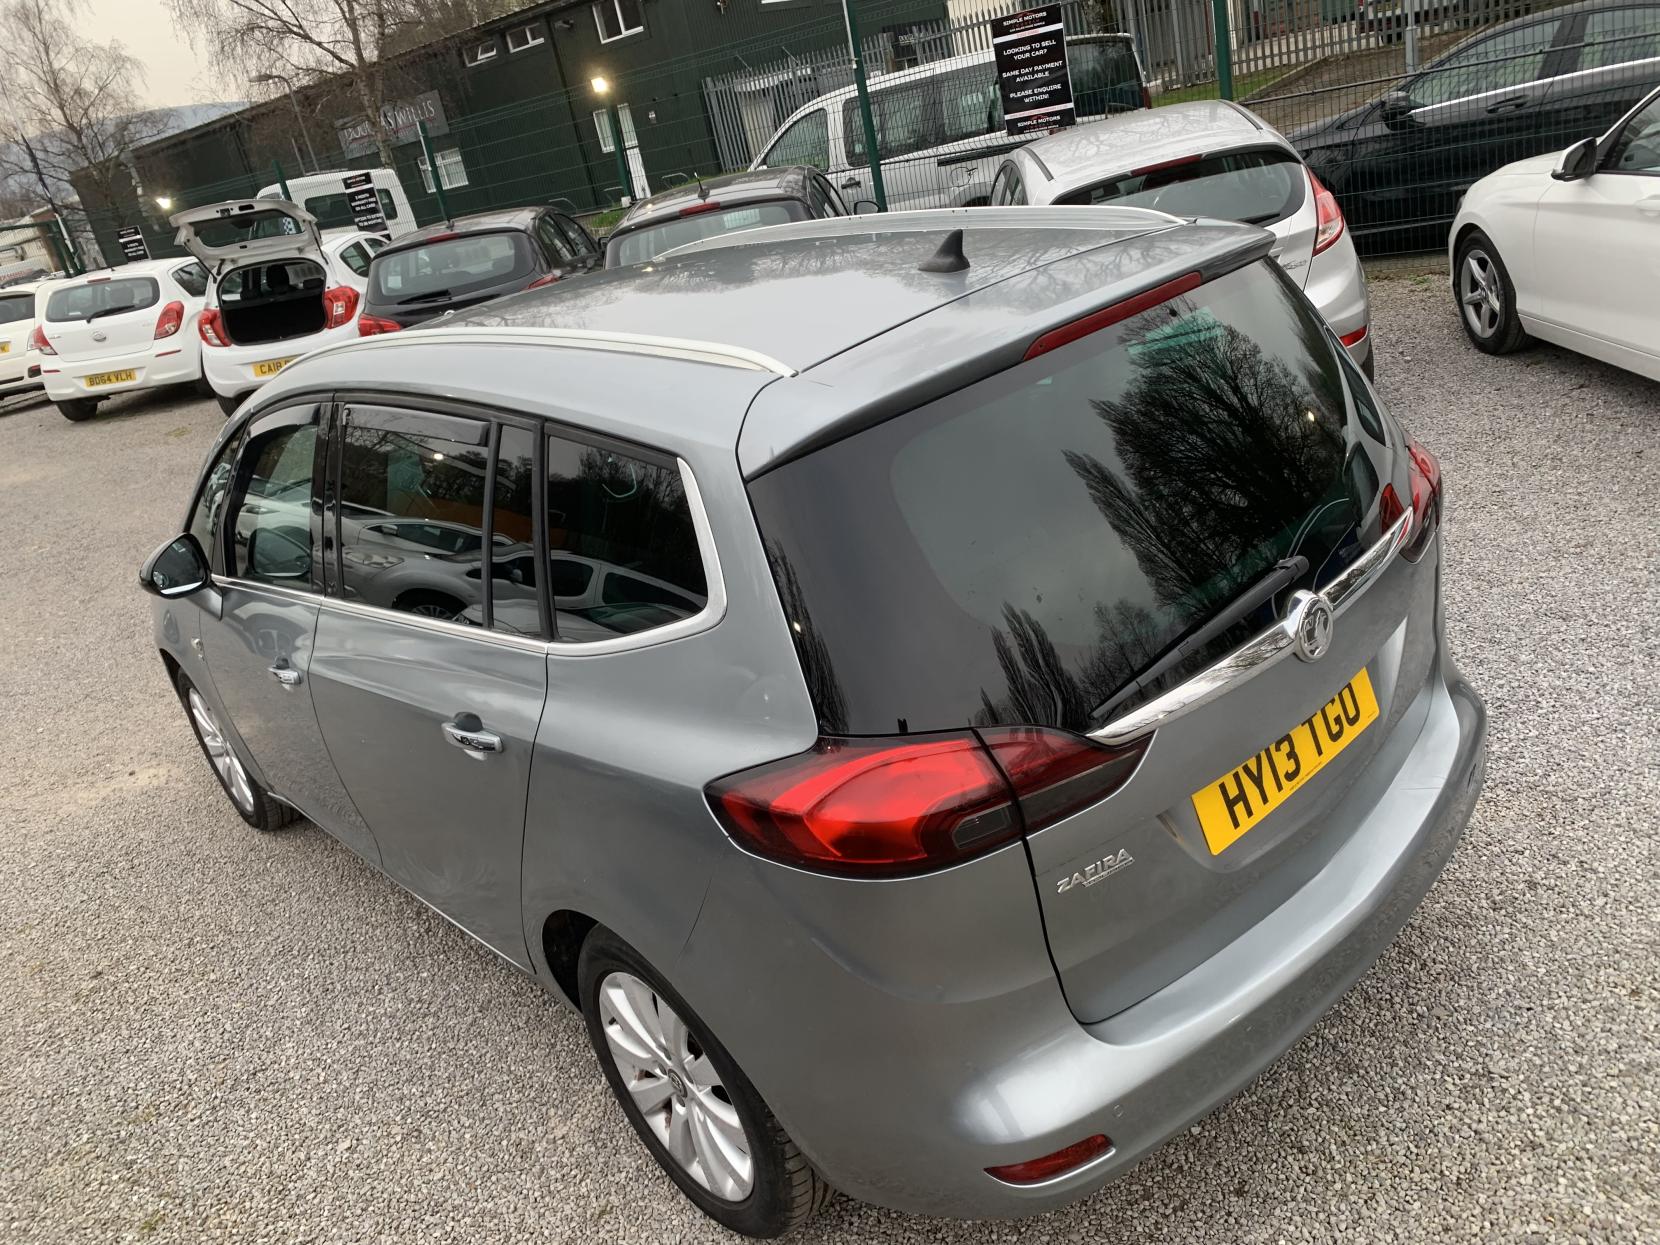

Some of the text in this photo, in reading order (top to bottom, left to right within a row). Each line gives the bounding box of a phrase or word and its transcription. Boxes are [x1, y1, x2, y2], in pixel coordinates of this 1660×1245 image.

[1024, 12, 1047, 20] MOTORS
[1003, 45, 1031, 55] LOOKING
[1013, 49, 1047, 60] YOUR CAR?
[1002, 60, 1063, 78] SAME DAY PAYMENT
[1015, 71, 1049, 83] AVAILABLE
[1010, 84, 1062, 98] PLEASE ENQUIRE
[395, 100, 435, 125] WILLIS
[1038, 115, 1060, 123] MOTORS
[1218, 682, 1361, 830] HY13 TGO
[1057, 848, 1132, 893] ZAFIRA
